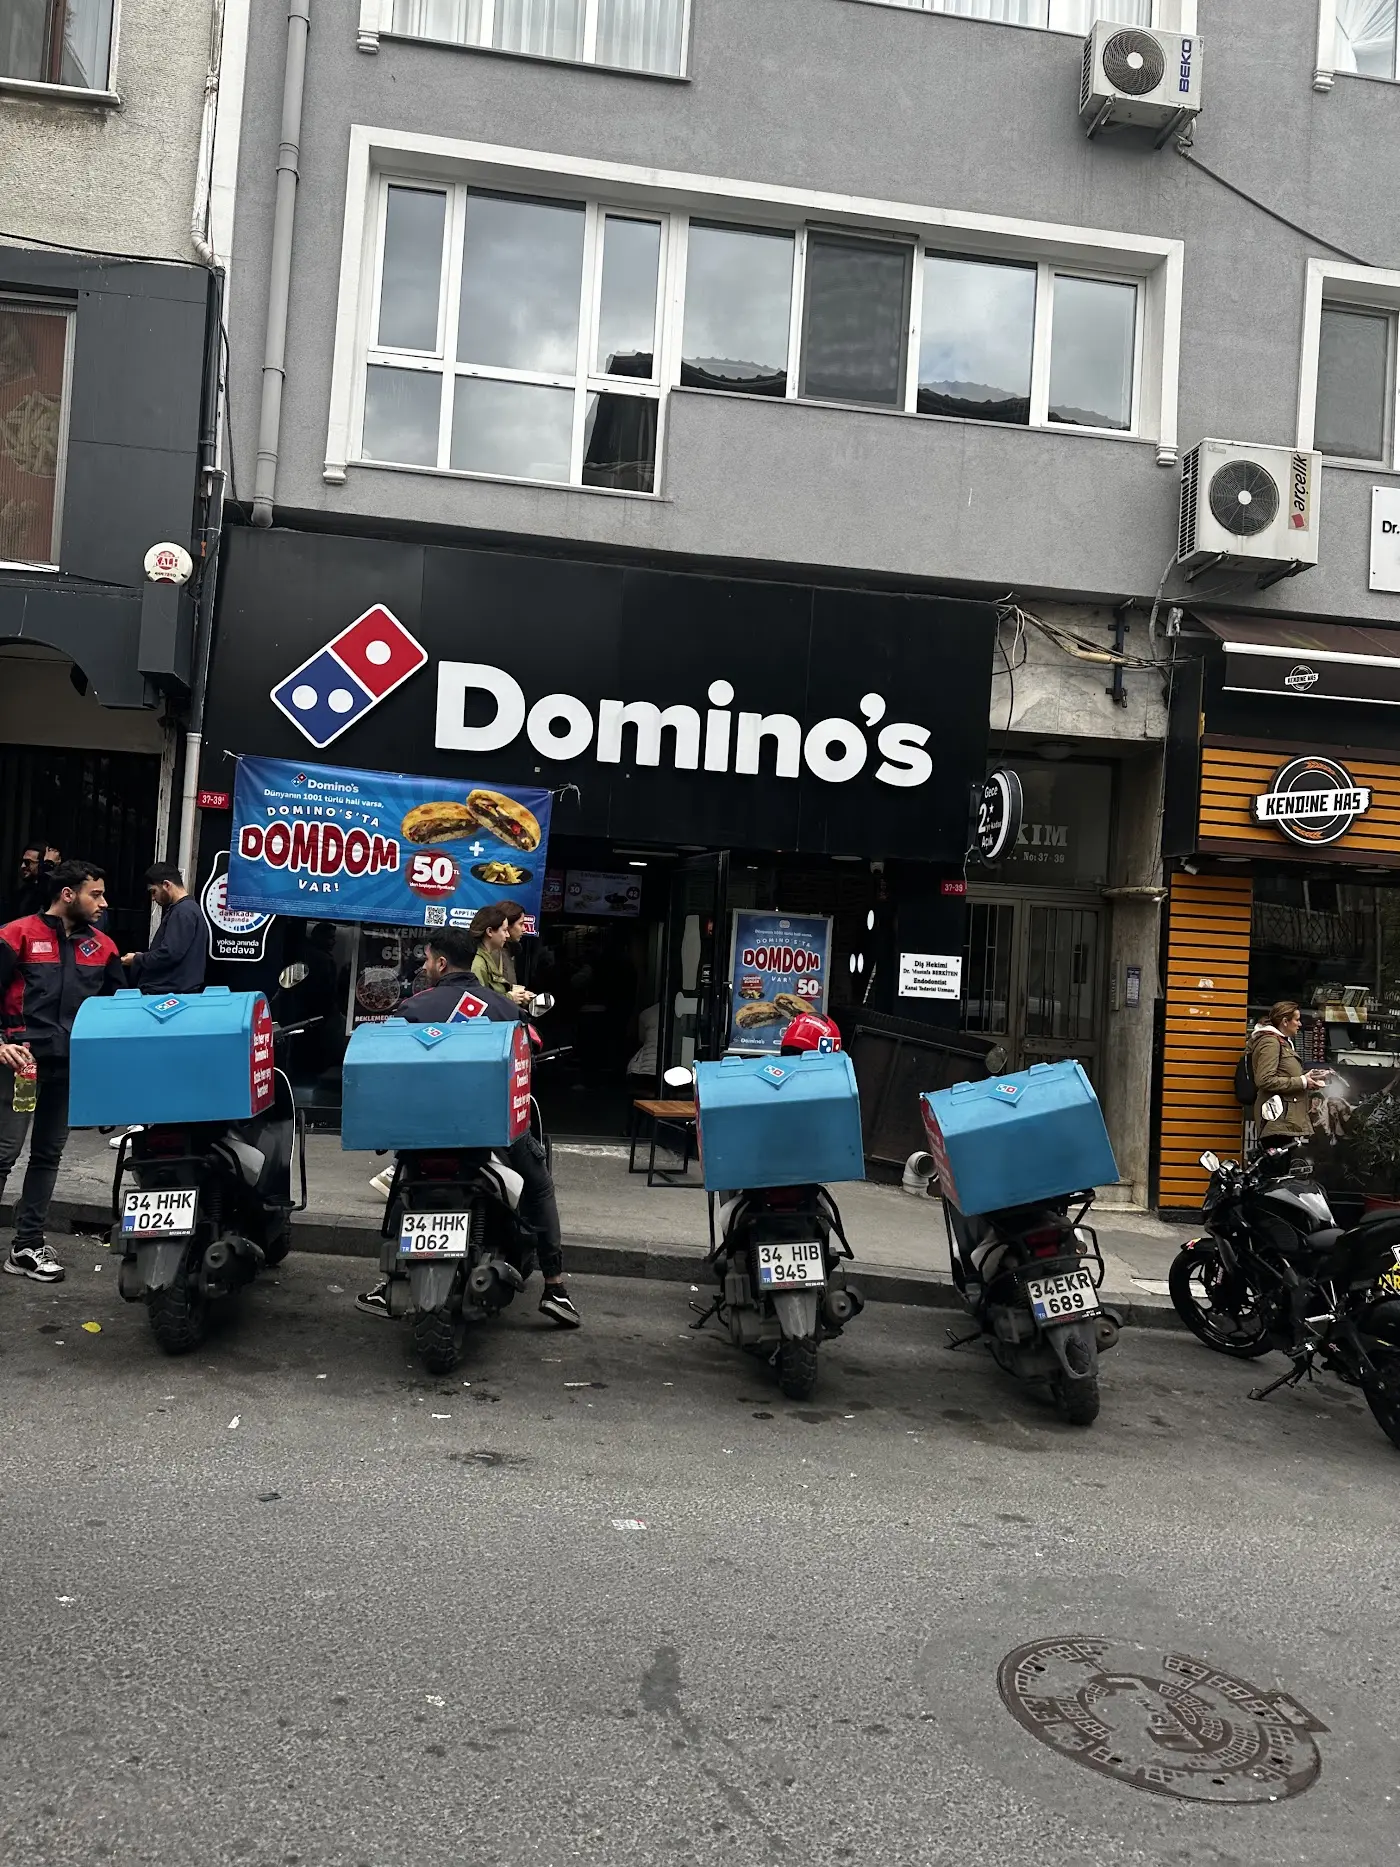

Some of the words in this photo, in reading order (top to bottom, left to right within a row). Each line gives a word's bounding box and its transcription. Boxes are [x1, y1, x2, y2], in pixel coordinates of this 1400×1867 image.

[1179, 39, 1192, 93] BEKO
[1293, 453, 1308, 511] arçelik
[1382, 520, 1400, 534] Dr.
[435, 660, 933, 788] Domino's
[307, 779, 359, 794] Domino's
[984, 786, 998, 798] Gece
[264, 789, 302, 801] Dünyanın
[303, 793, 322, 802] 1001
[324, 795, 344, 804] türlü
[345, 797, 360, 806] hali
[361, 800, 385, 809] varsa,
[1333, 792, 1362, 812] HAS
[239, 820, 401, 878] DOMDOM
[411, 855, 454, 885] 50
[298, 879, 340, 894] VAR!
[944, 883, 963, 893] 37-39
[217, 939, 236, 948] yoksa
[219, 945, 255, 955] bedava
[742, 945, 821, 975] DOMDOM
[926, 961, 948, 969] Hekimi
[797, 979, 819, 995] 50
[127, 1194, 151, 1211] 34
[157, 1192, 193, 1210] HHK
[138, 1212, 175, 1229] 024
[404, 1216, 427, 1232] 34
[432, 1215, 466, 1231] HHK
[415, 1234, 449, 1250] 062
[761, 1247, 782, 1263] 34
[792, 1245, 819, 1261] HIB
[774, 1263, 807, 1281] 945
[1048, 1293, 1084, 1314] 689
